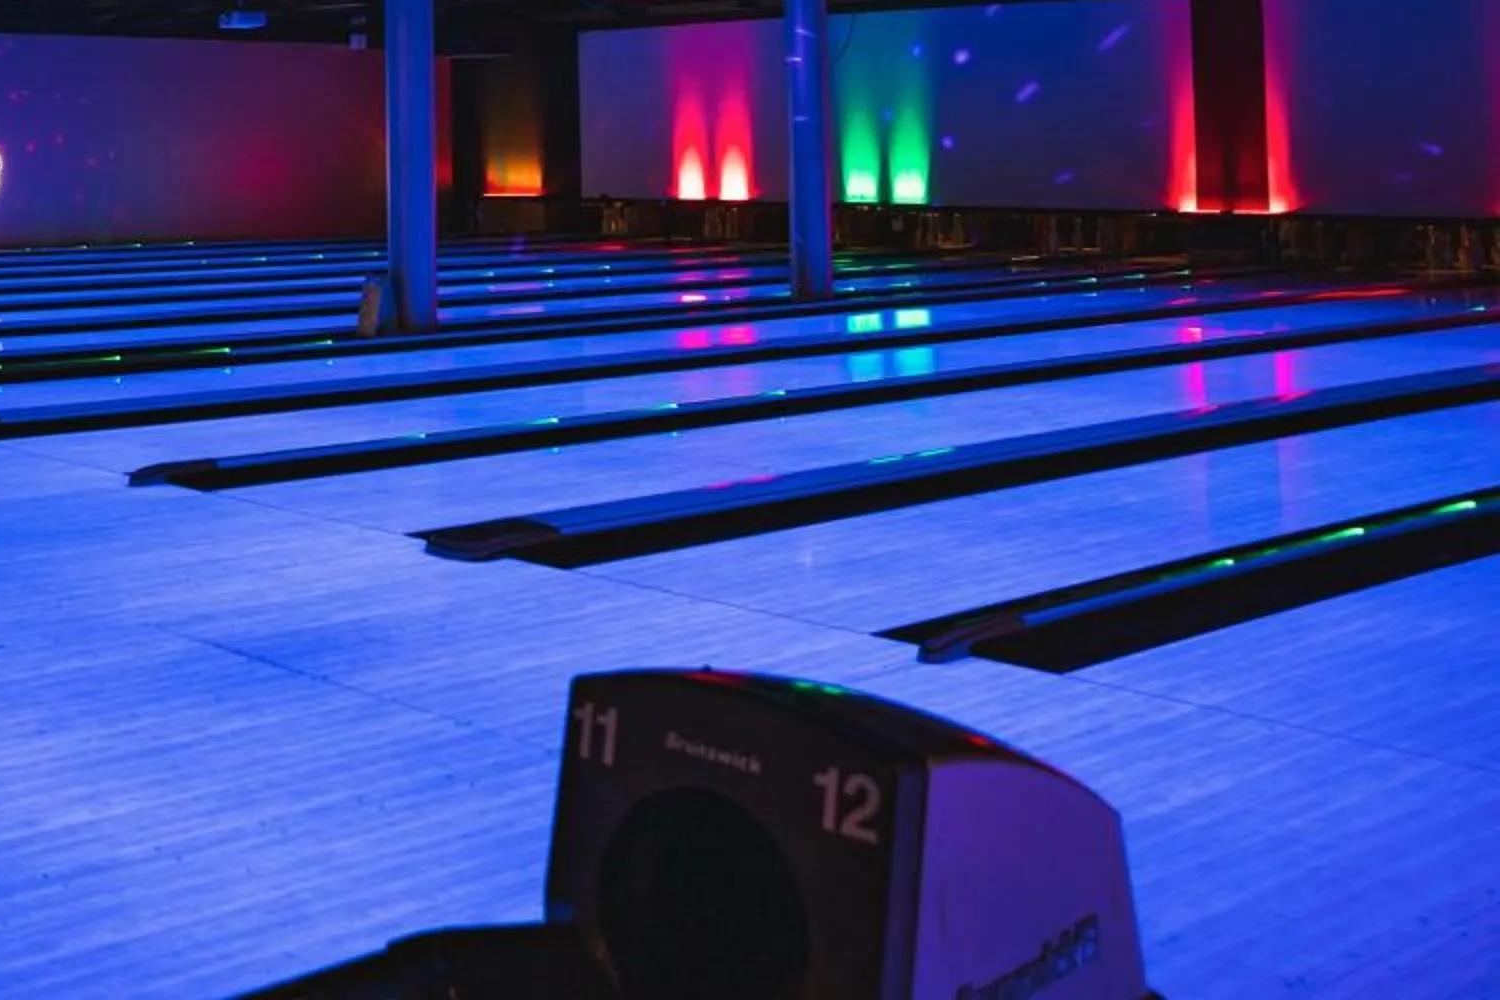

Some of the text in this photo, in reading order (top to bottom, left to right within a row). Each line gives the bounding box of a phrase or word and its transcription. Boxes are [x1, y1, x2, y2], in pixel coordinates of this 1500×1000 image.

[574, 702, 618, 767] 11
[665, 729, 762, 775] Brunswick
[813, 766, 881, 846] 12
